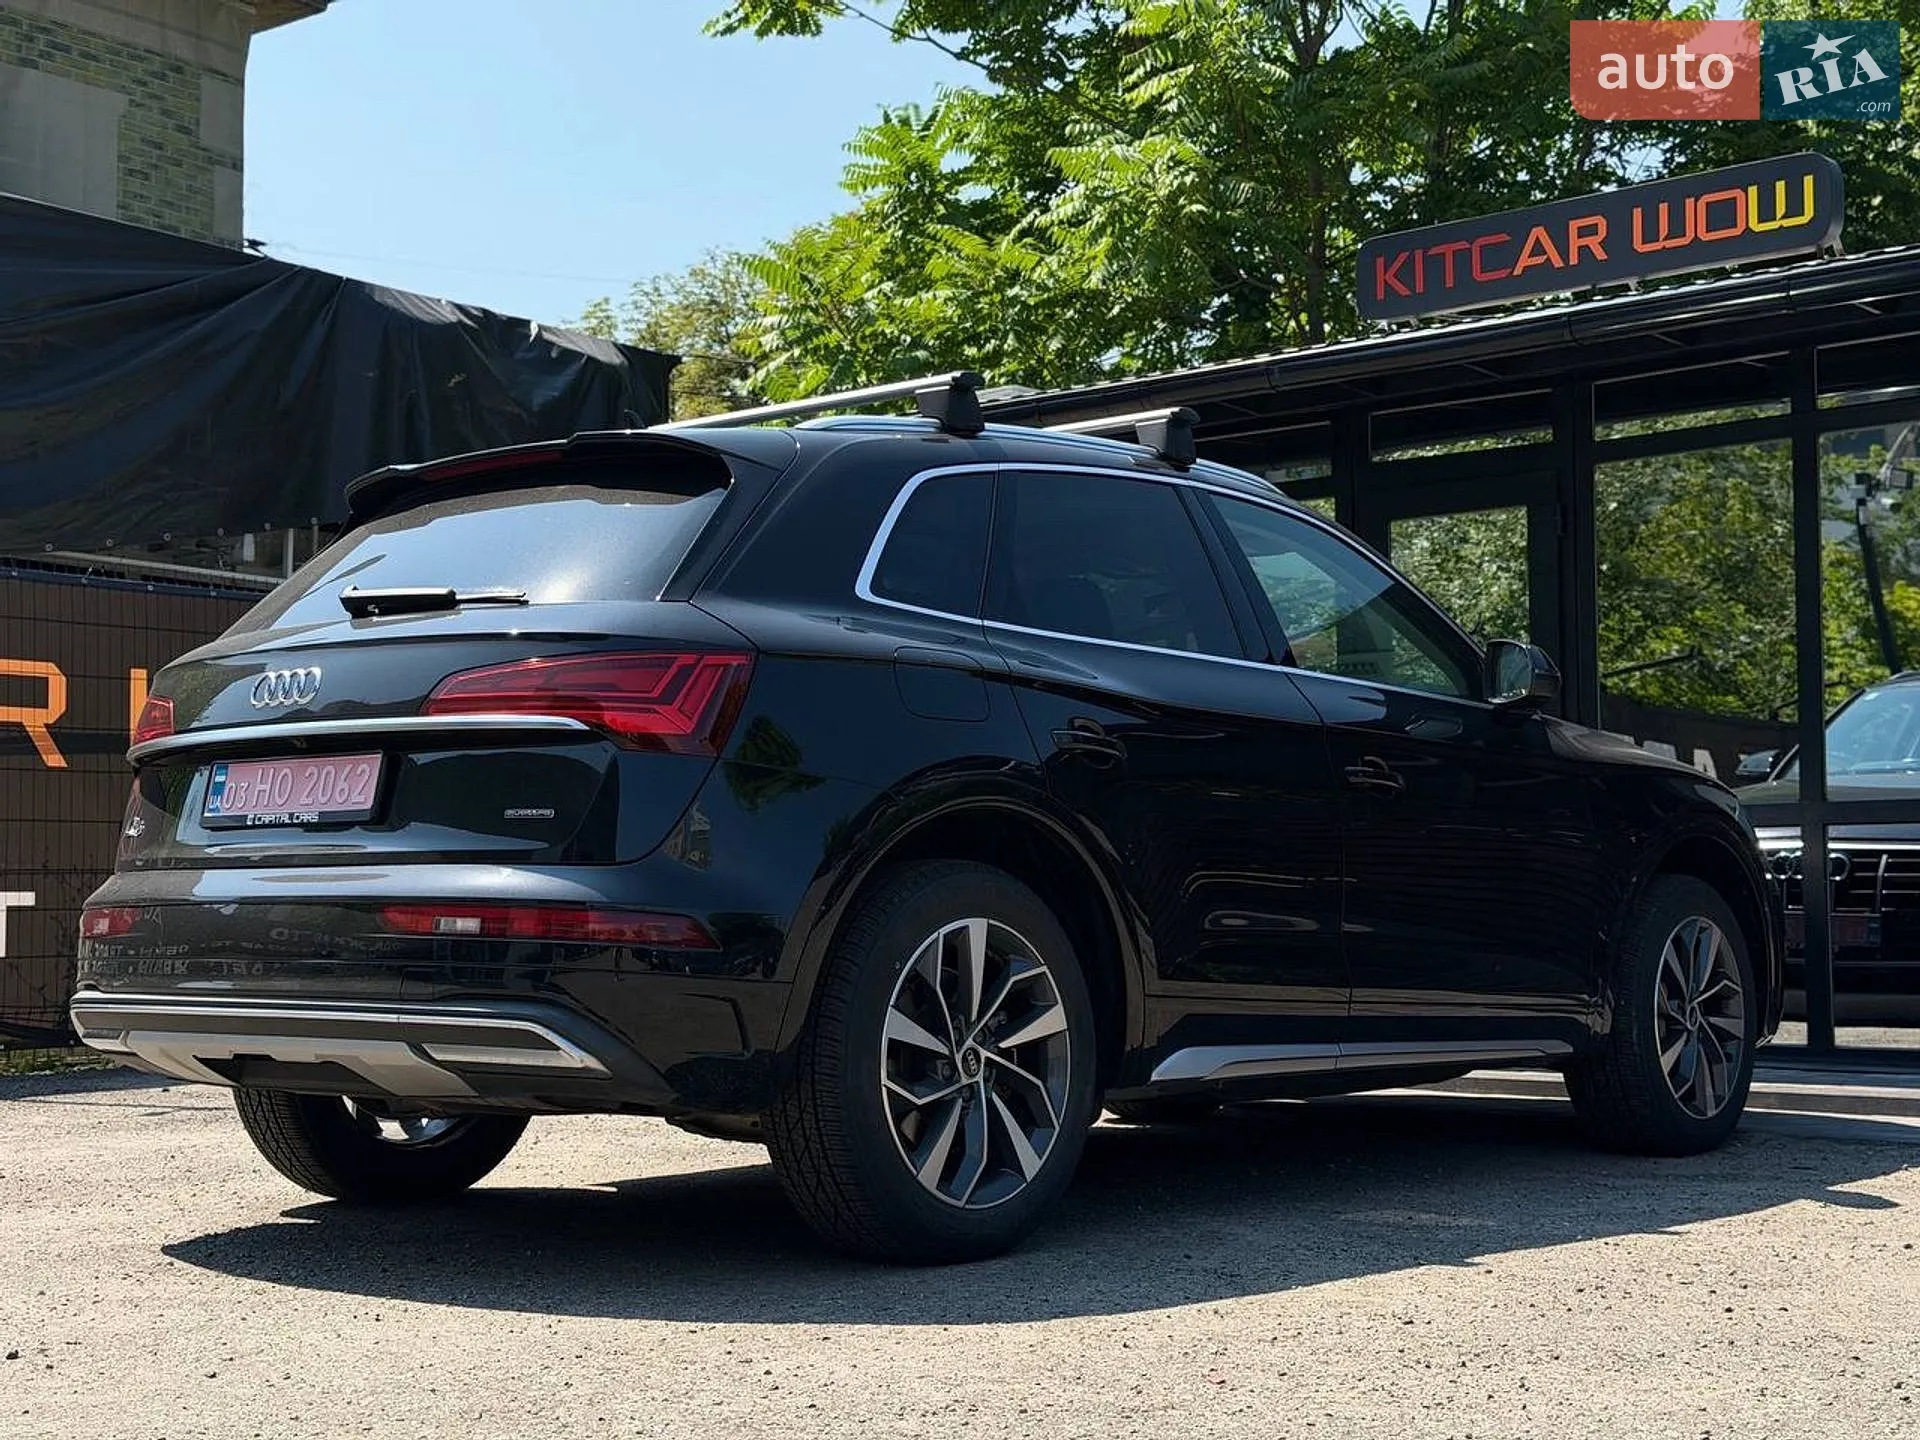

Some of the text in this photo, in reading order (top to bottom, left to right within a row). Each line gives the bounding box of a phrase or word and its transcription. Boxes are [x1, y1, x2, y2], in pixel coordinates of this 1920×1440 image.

[1375, 174, 1815, 301] KITCAR WOW
[299, 763, 371, 806] 2062
